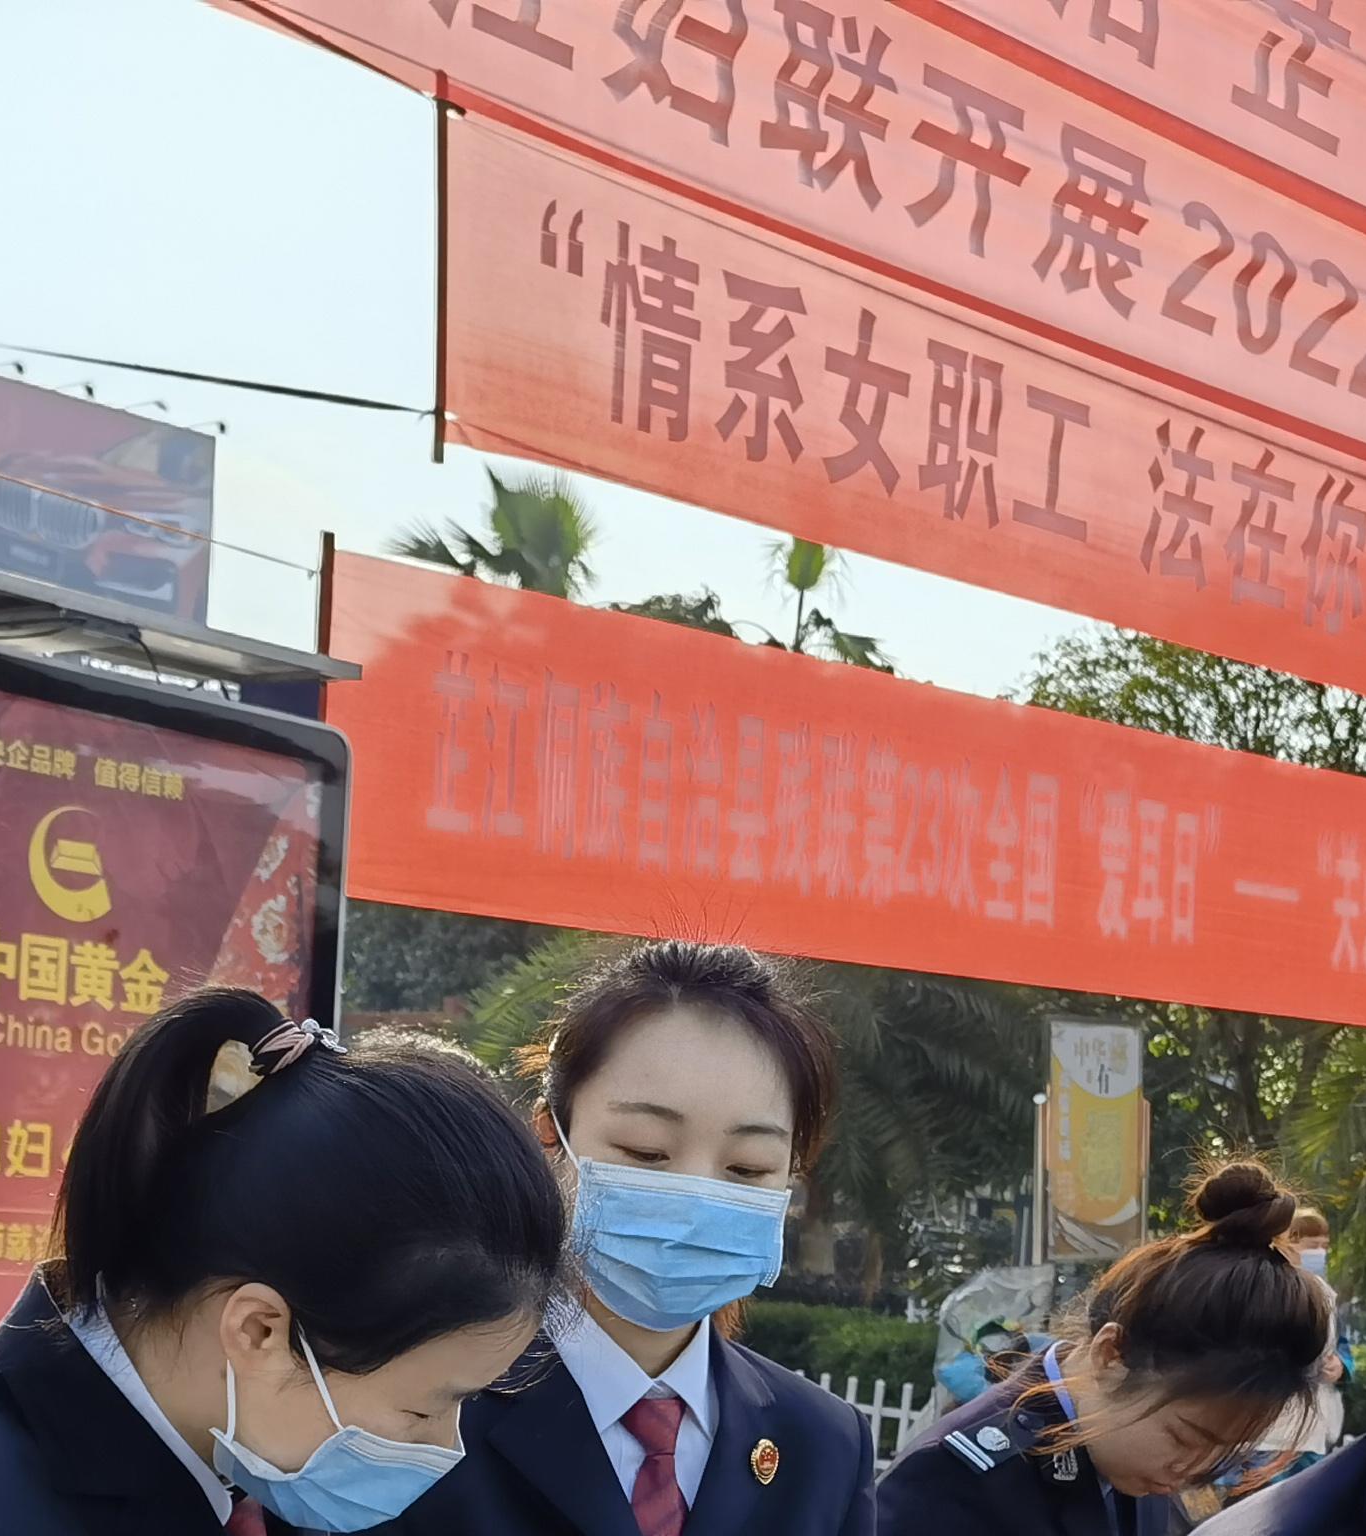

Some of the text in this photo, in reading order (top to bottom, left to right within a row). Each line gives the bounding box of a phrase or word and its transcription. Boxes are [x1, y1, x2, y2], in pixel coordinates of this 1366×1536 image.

[94, 757, 185, 801] 值得信赖
[81, 1022, 134, 1058] Go
